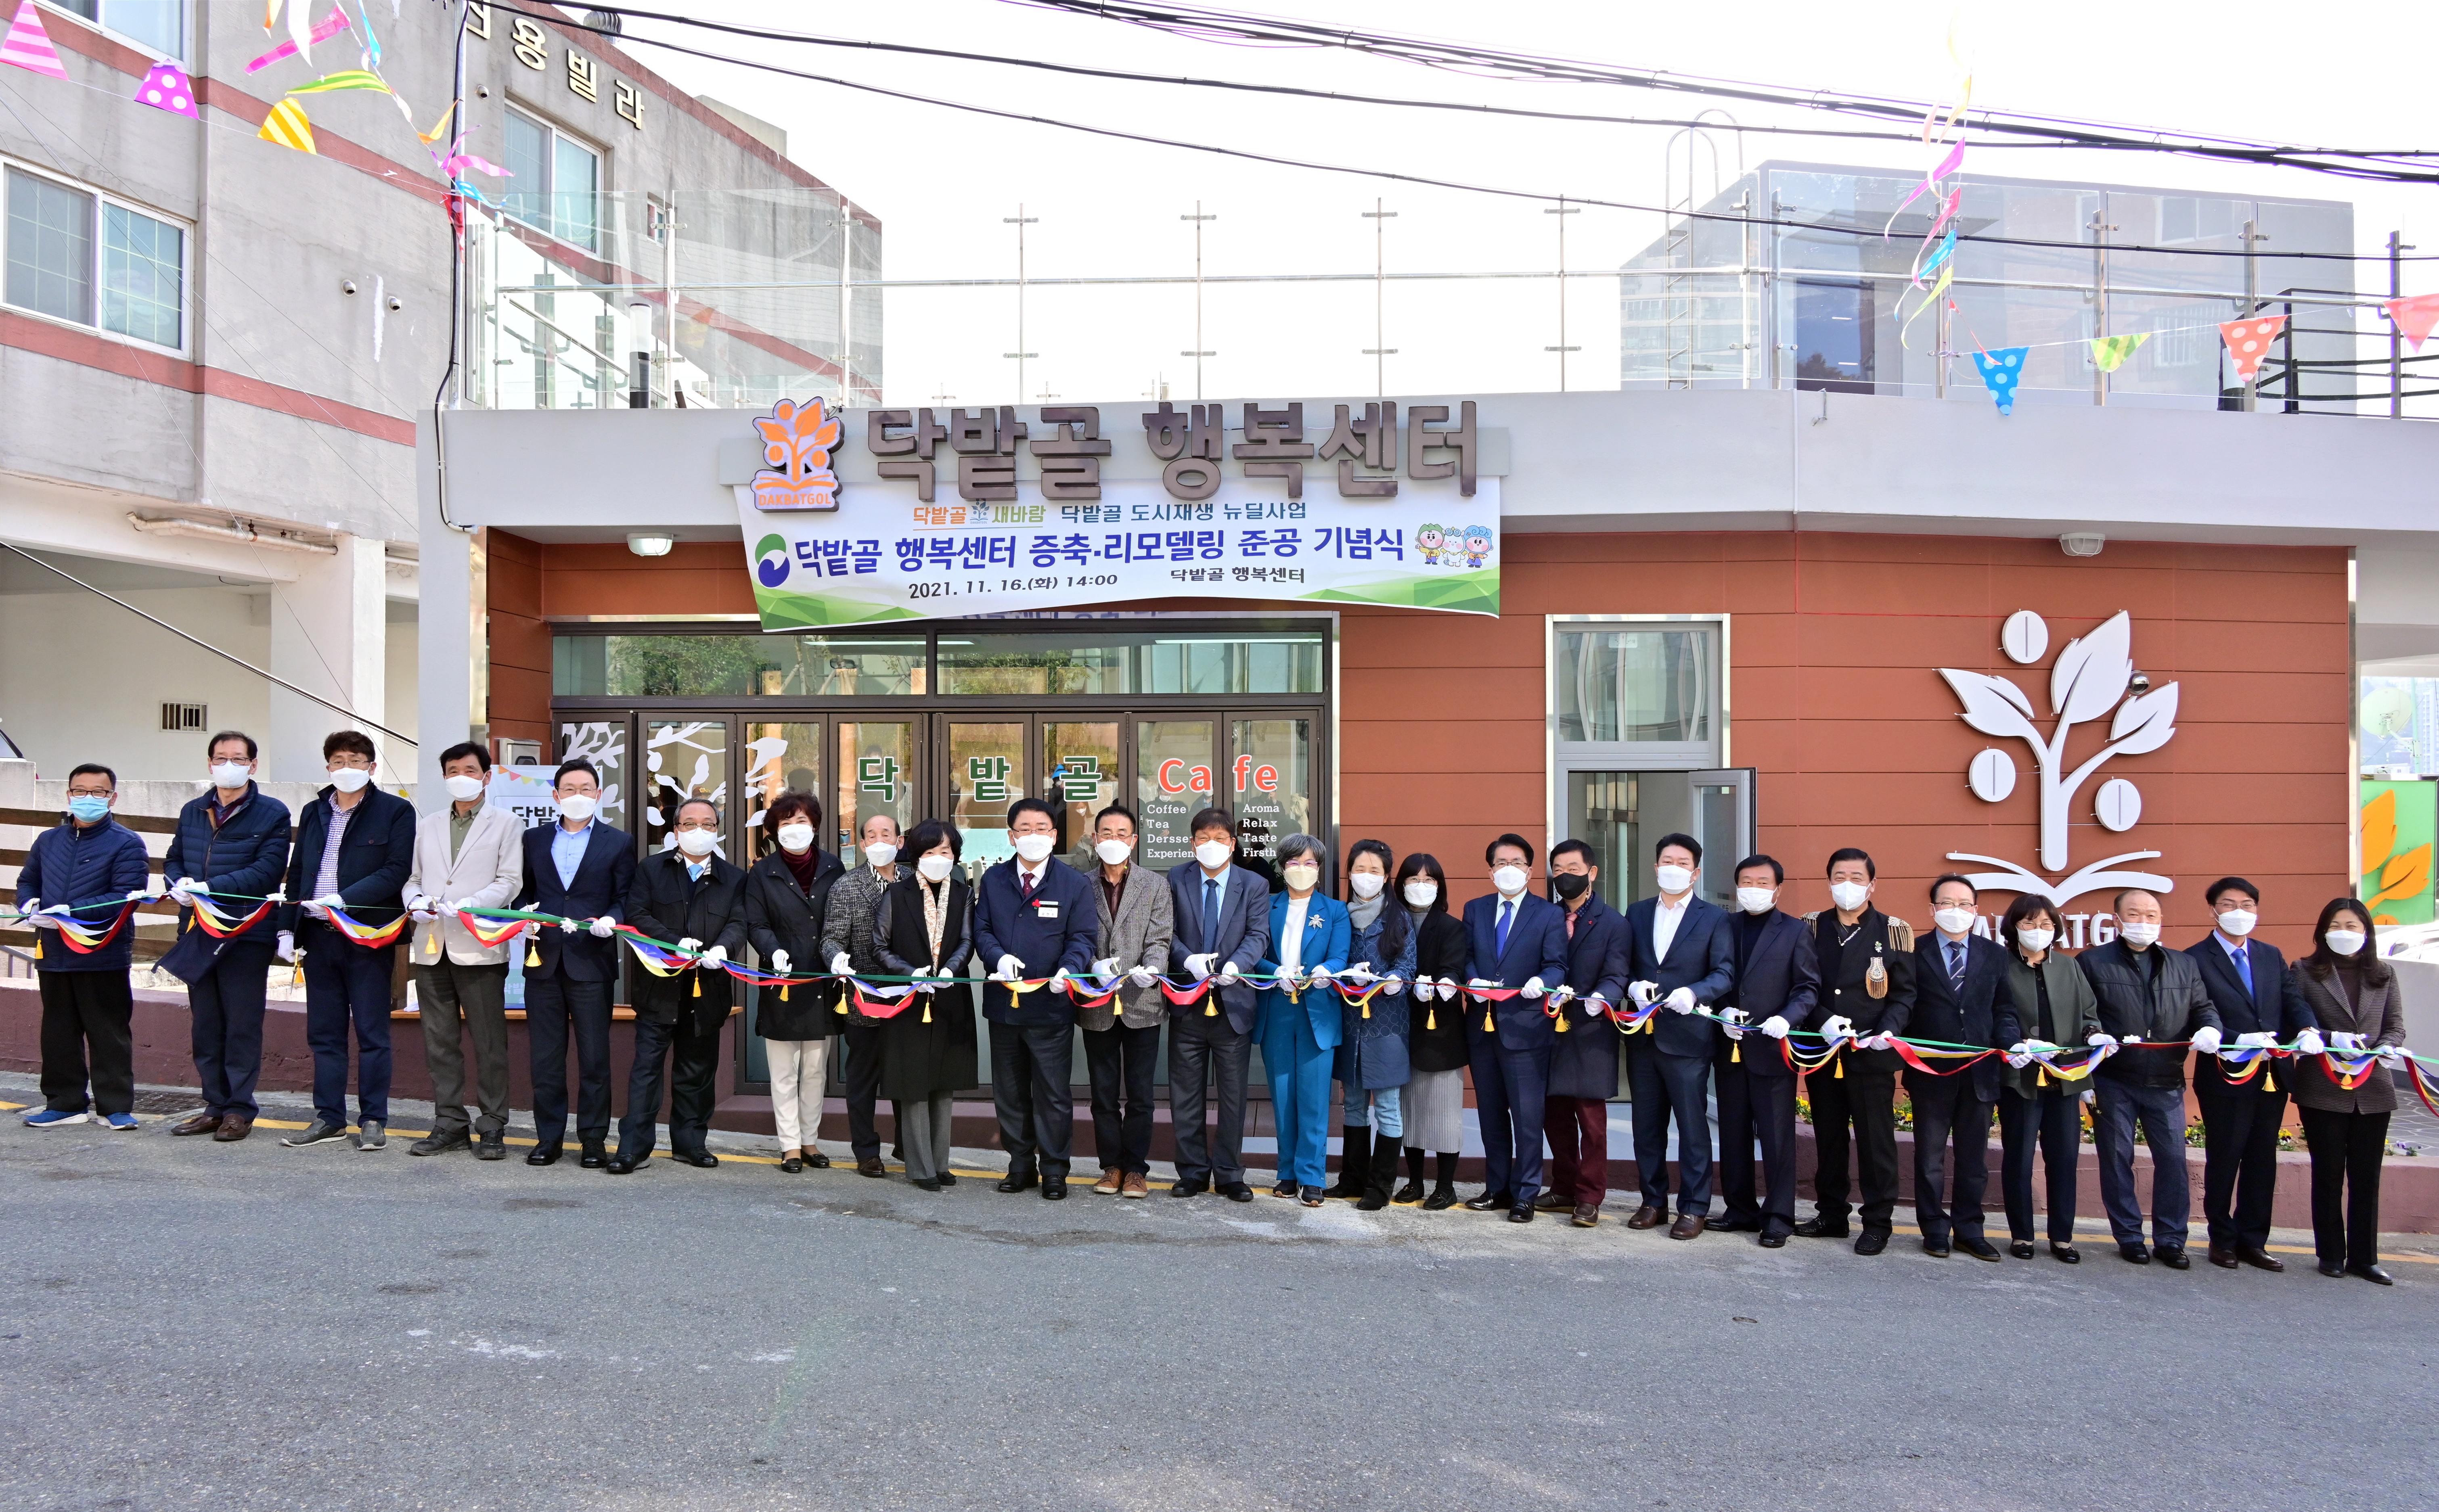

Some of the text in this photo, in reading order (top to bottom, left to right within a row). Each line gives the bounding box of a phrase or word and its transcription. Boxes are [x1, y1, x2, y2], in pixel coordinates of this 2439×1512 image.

[868, 402, 1477, 502] 닥밭골 행복센터
[758, 493, 831, 506] DAKBATGOL
[913, 505, 1047, 525] 닥밭골 새바람
[1061, 502, 1306, 523] 닥밭골 도시재생 뉴딜사업
[795, 539, 882, 577] 닥밭골
[895, 535, 1016, 572] 행복센터
[1238, 528, 1302, 557] 준공
[1313, 527, 1403, 561] 기념식
[1170, 567, 1305, 583] 닥밭골 행복센터
[908, 582, 957, 599] 2021.
[967, 581, 992, 594] 11.
[1067, 574, 1118, 587] 14:00
[1147, 805, 1187, 814] Coffee
[1243, 803, 1279, 812] Aroma
[512, 806, 561, 829] 닥밭
[1147, 819, 1169, 828] Tea
[1243, 818, 1277, 827] Relax
[1243, 833, 1277, 842] Taste
